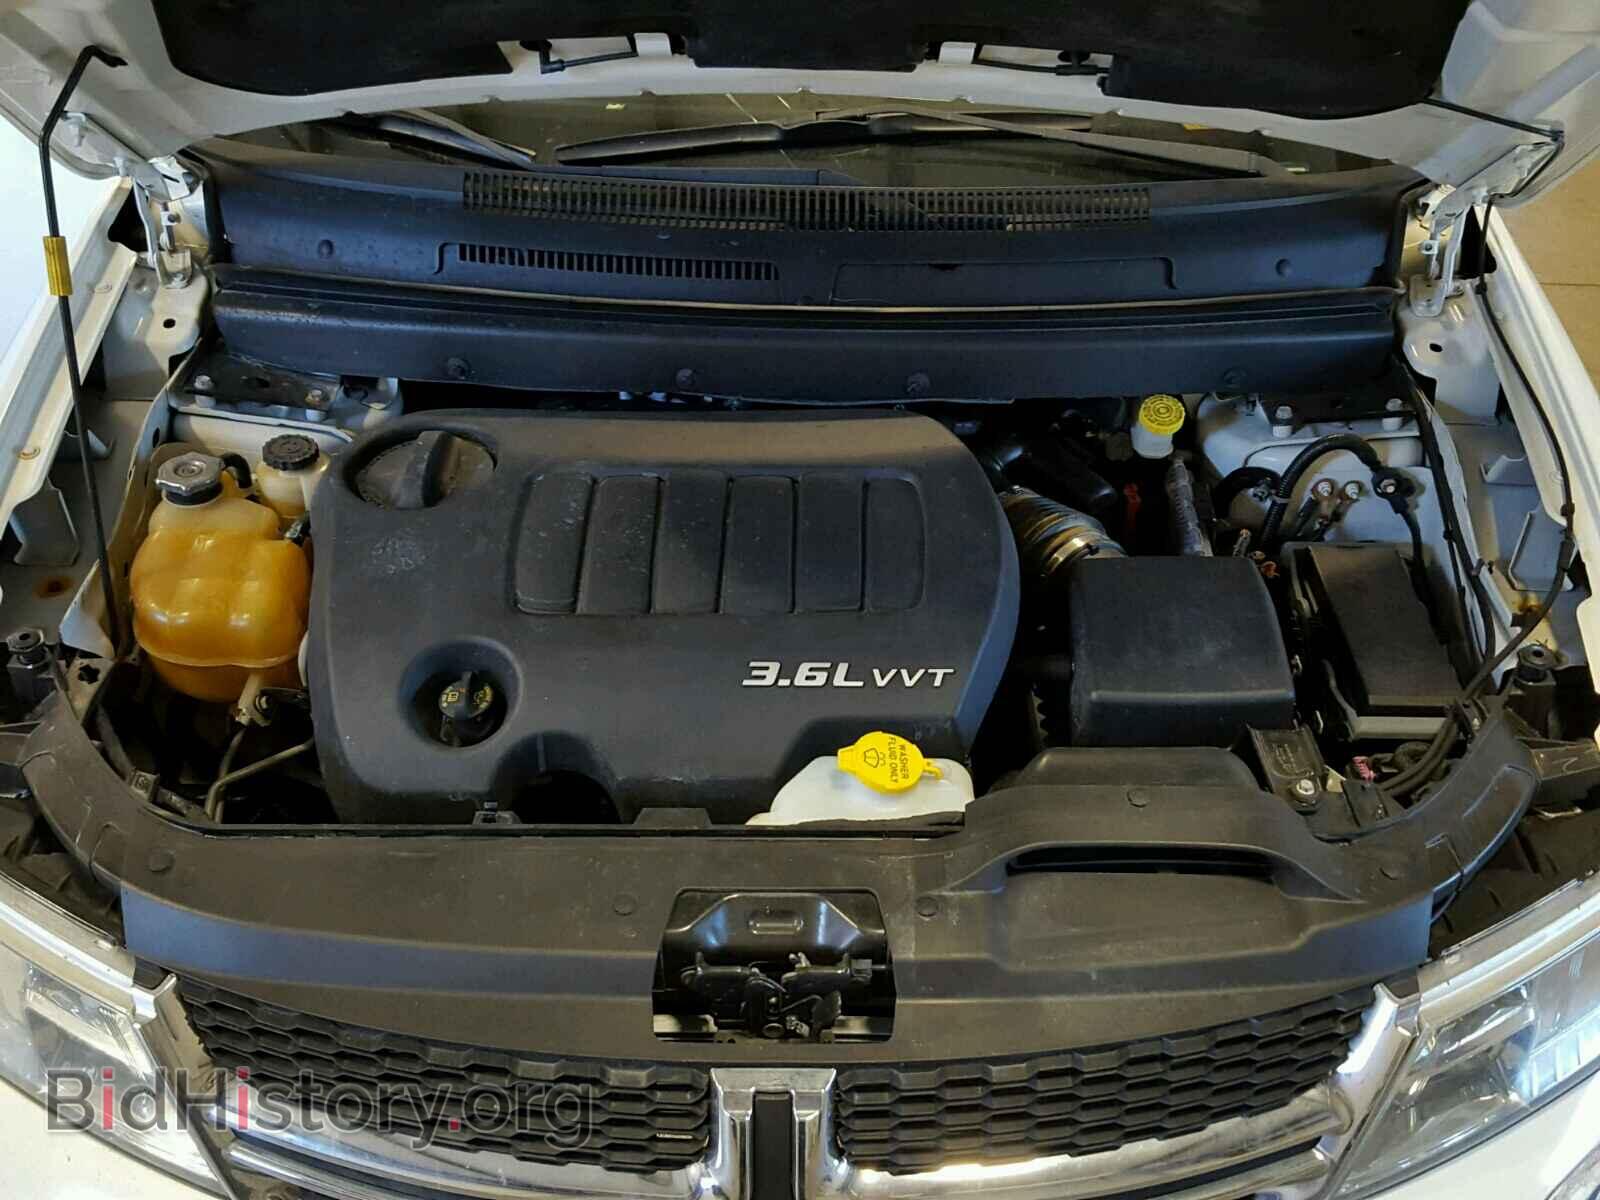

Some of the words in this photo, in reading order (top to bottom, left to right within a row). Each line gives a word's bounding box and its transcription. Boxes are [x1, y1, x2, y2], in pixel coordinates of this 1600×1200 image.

[742, 661, 865, 687] 3.6L
[872, 668, 955, 688] VVT
[887, 735, 897, 760] FLUID
[889, 762, 898, 783] ONLY
[898, 744, 909, 779] WASHER
